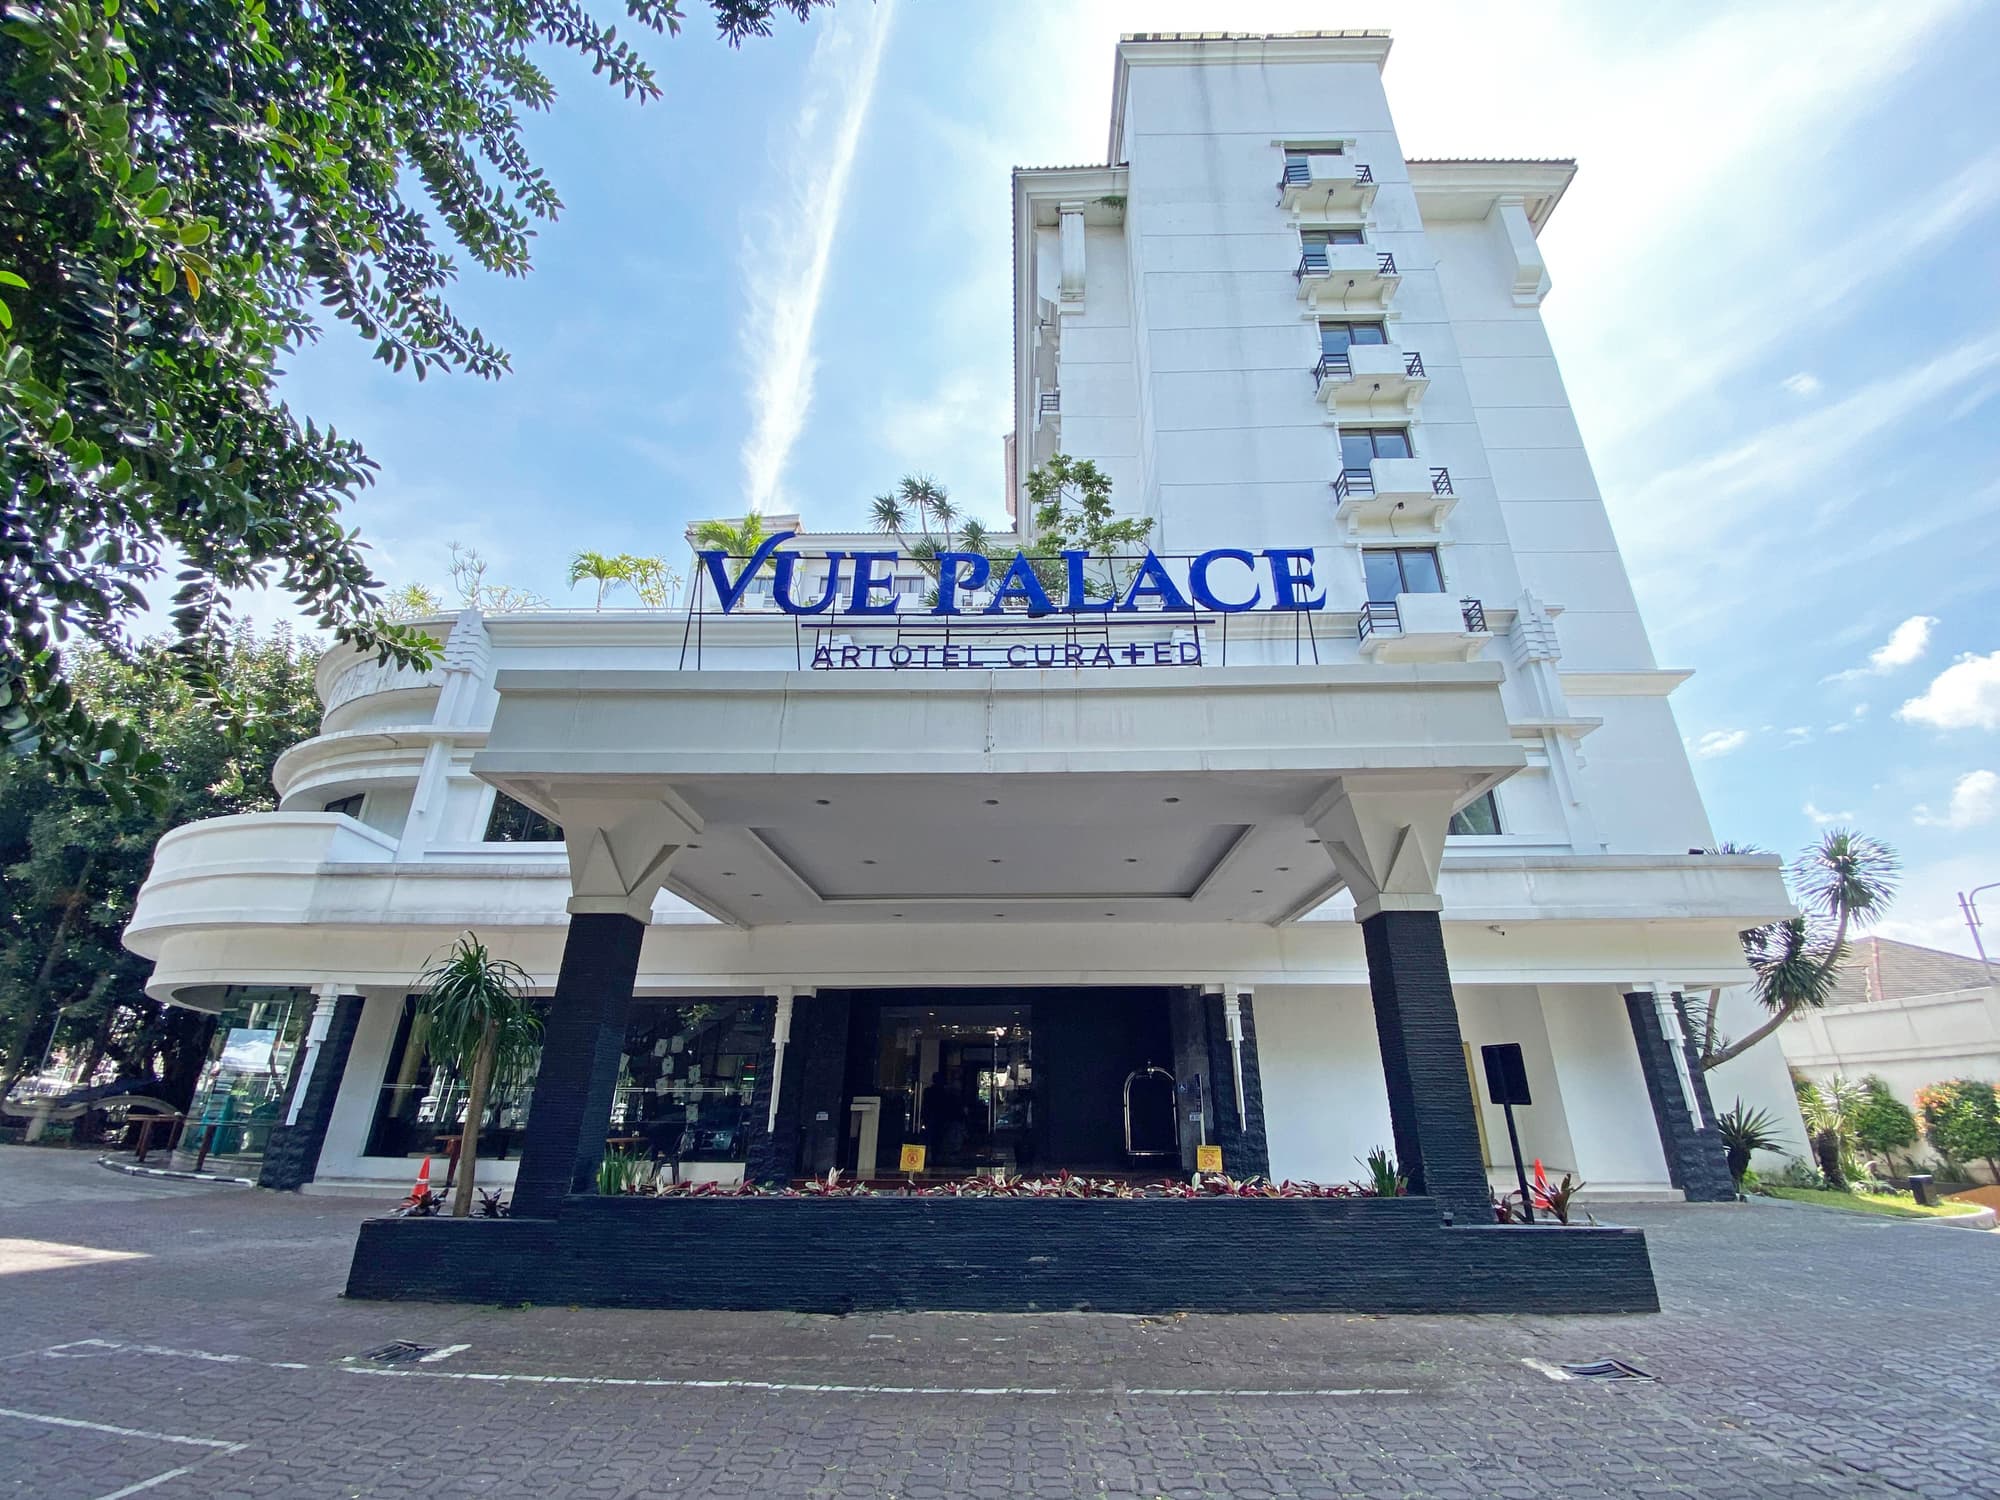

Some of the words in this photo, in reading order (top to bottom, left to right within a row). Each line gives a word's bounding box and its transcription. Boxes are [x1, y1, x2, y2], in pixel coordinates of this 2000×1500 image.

[697, 530, 901, 617] VUE
[931, 547, 1327, 618] PALACE
[810, 644, 984, 670] ARTOTEL
